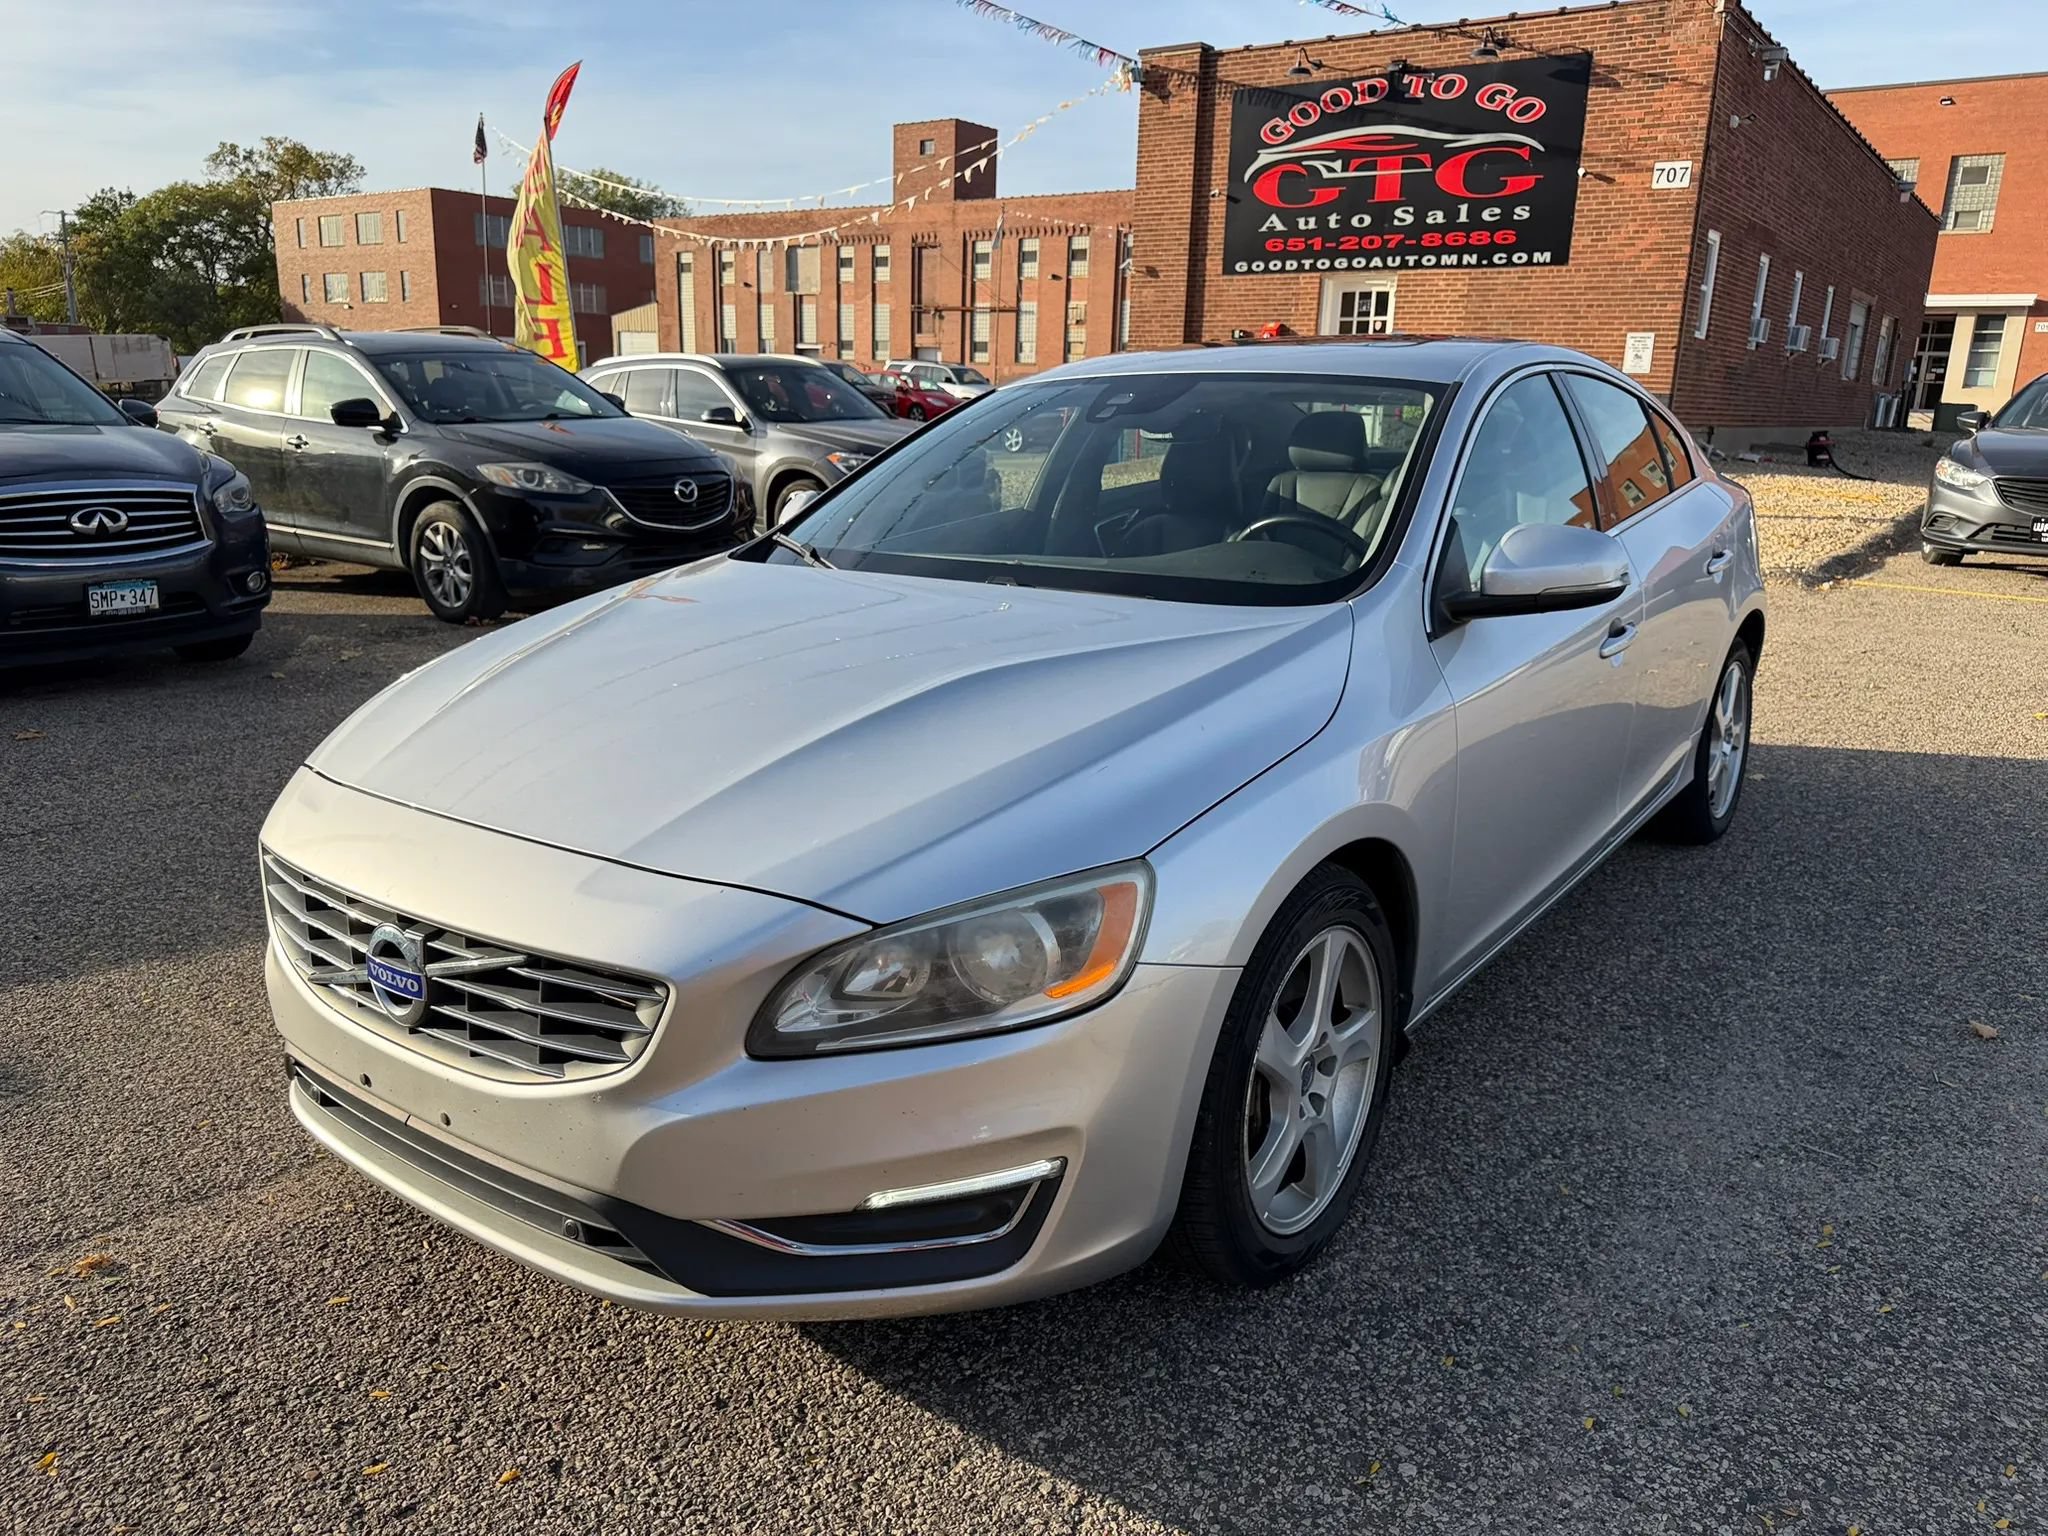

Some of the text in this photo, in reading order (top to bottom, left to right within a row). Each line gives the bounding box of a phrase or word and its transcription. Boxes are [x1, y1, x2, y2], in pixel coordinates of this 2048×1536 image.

[1260, 73, 1547, 144] GOOD TO GO
[1253, 146, 1544, 208] GTG
[1655, 166, 1690, 184] 707
[1258, 203, 1531, 233] Auto Sales
[1265, 230, 1517, 252] 651-207-8686
[1234, 251, 1552, 273] GOODTOGOAUTOMN.COM
[90, 587, 155, 609] SMP 347
[368, 961, 419, 992] VOLVO
